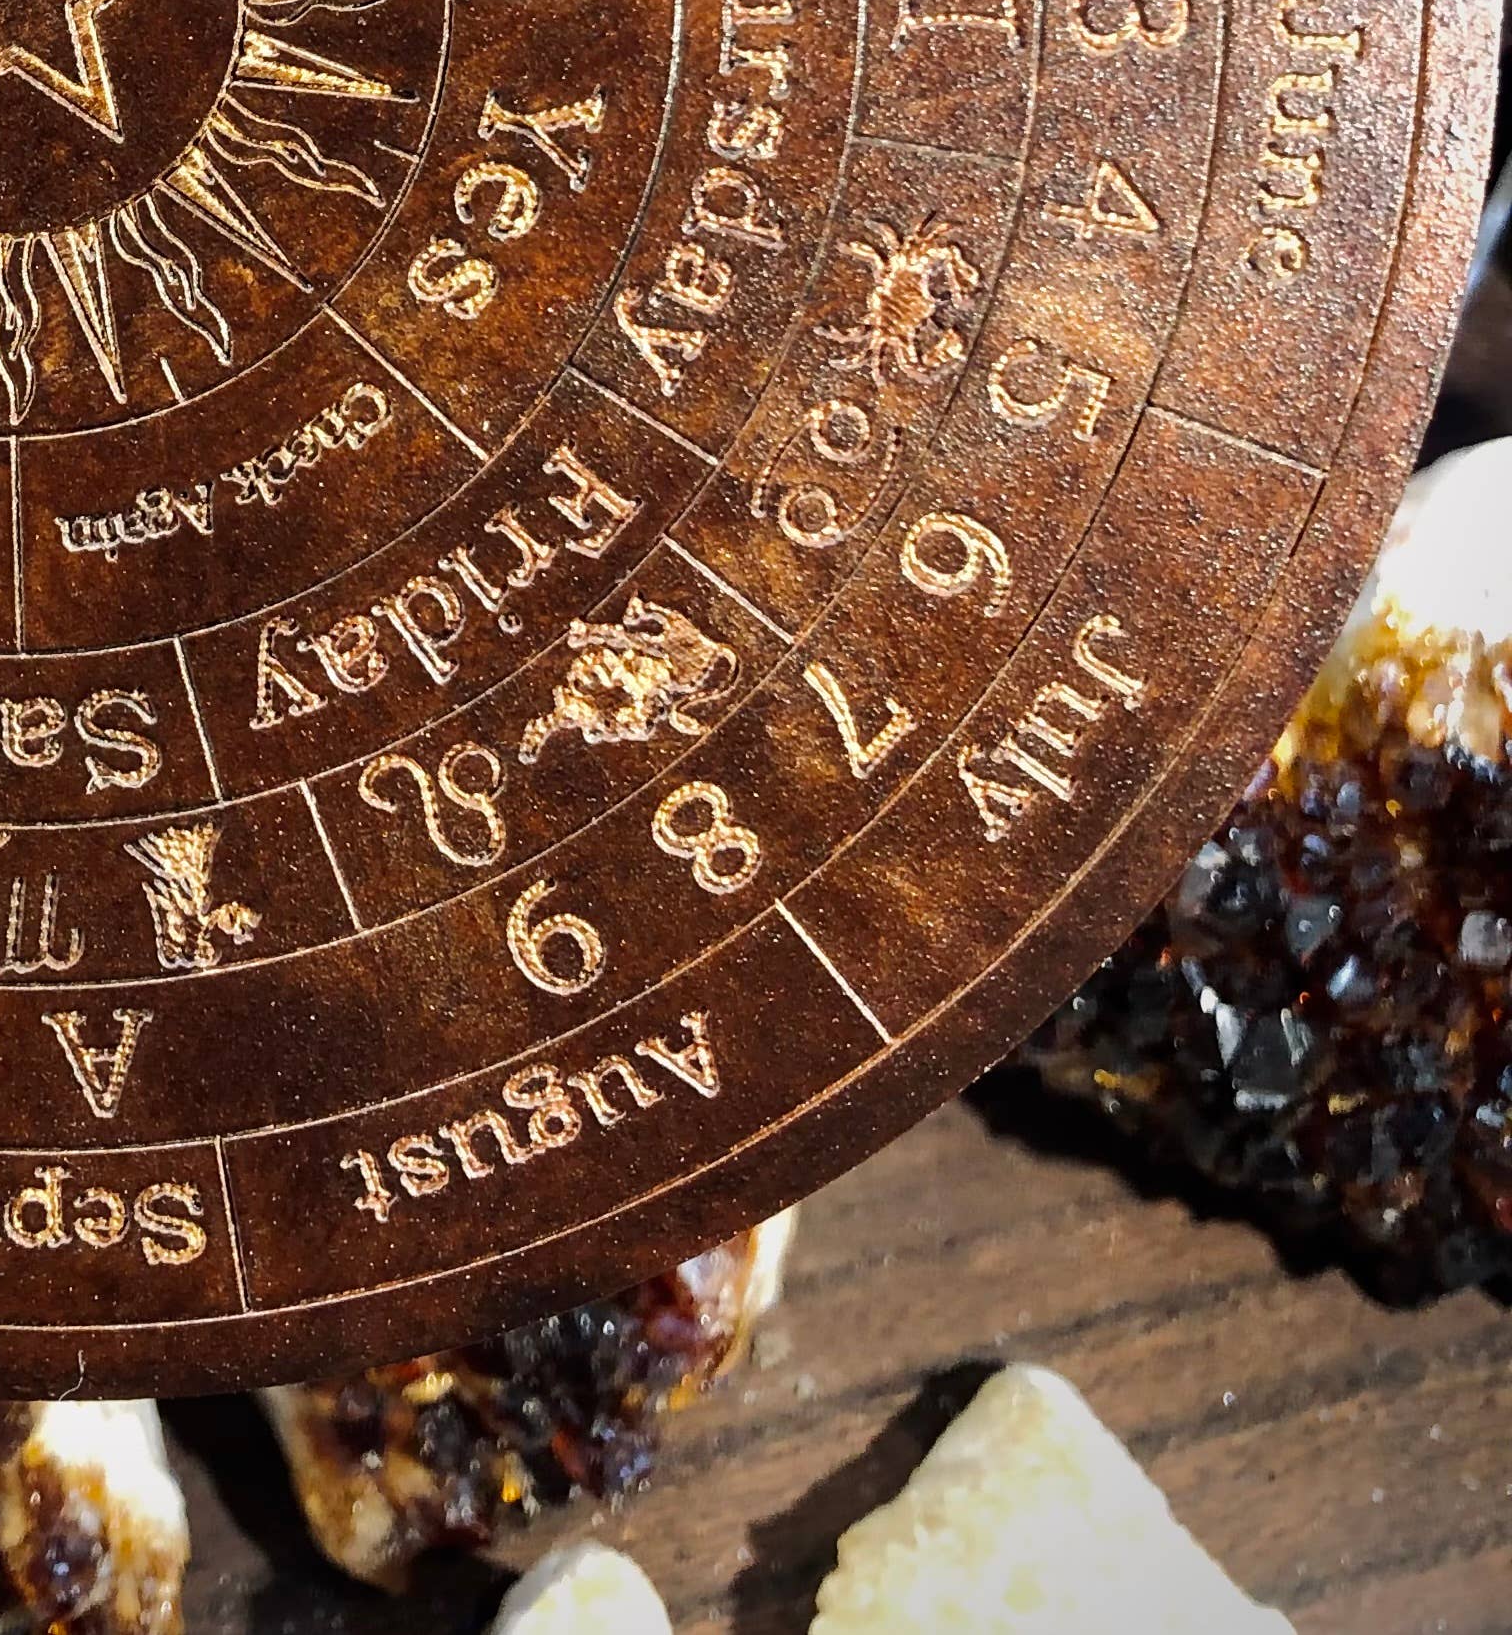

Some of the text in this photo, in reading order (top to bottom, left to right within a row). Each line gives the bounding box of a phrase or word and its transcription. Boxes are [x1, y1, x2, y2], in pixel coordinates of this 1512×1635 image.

[407, 86, 606, 320] Yes
[1042, 160, 1162, 238] 4
[988, 335, 1117, 444] 5
[55, 380, 393, 562] Check Again
[249, 438, 644, 731] Friday
[897, 509, 1013, 620] 6
[801, 659, 918, 781] 7
[958, 614, 1147, 843] July
[651, 779, 763, 897] 8
[505, 876, 607, 997] 9
[41, 1007, 154, 1119] A
[340, 1006, 721, 1222] August
